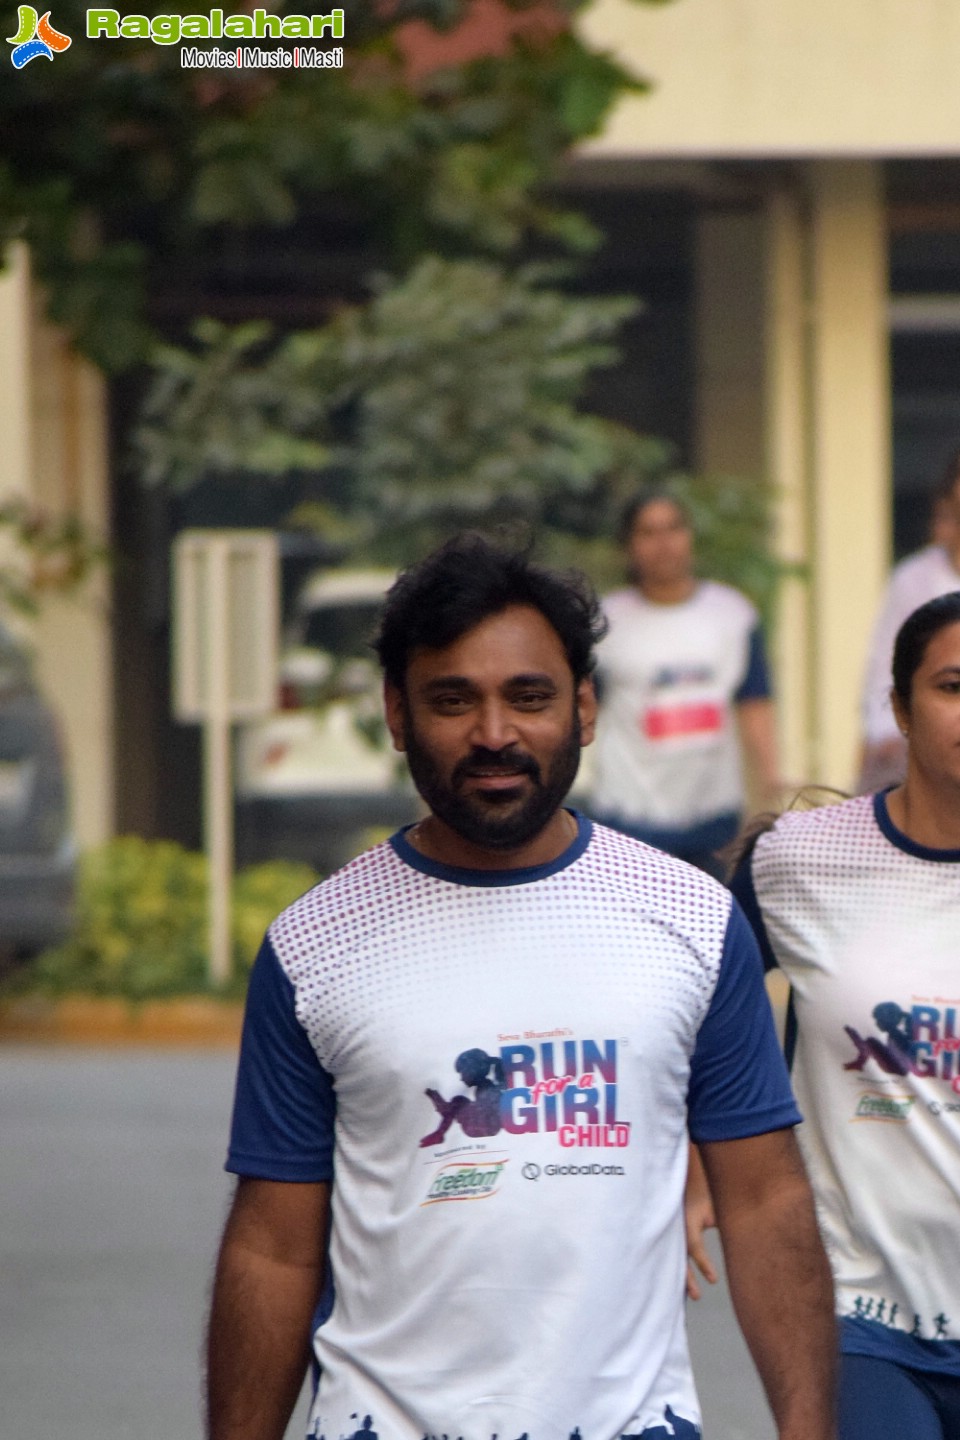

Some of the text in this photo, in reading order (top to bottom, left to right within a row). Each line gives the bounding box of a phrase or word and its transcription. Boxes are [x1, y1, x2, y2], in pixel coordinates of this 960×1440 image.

[500, 1039, 617, 1089] RUN
[530, 1072, 594, 1105] for a
[501, 1083, 630, 1135] GIRL
[558, 1124, 629, 1148] CHILD
[544, 1162, 626, 1176] GlobalData
